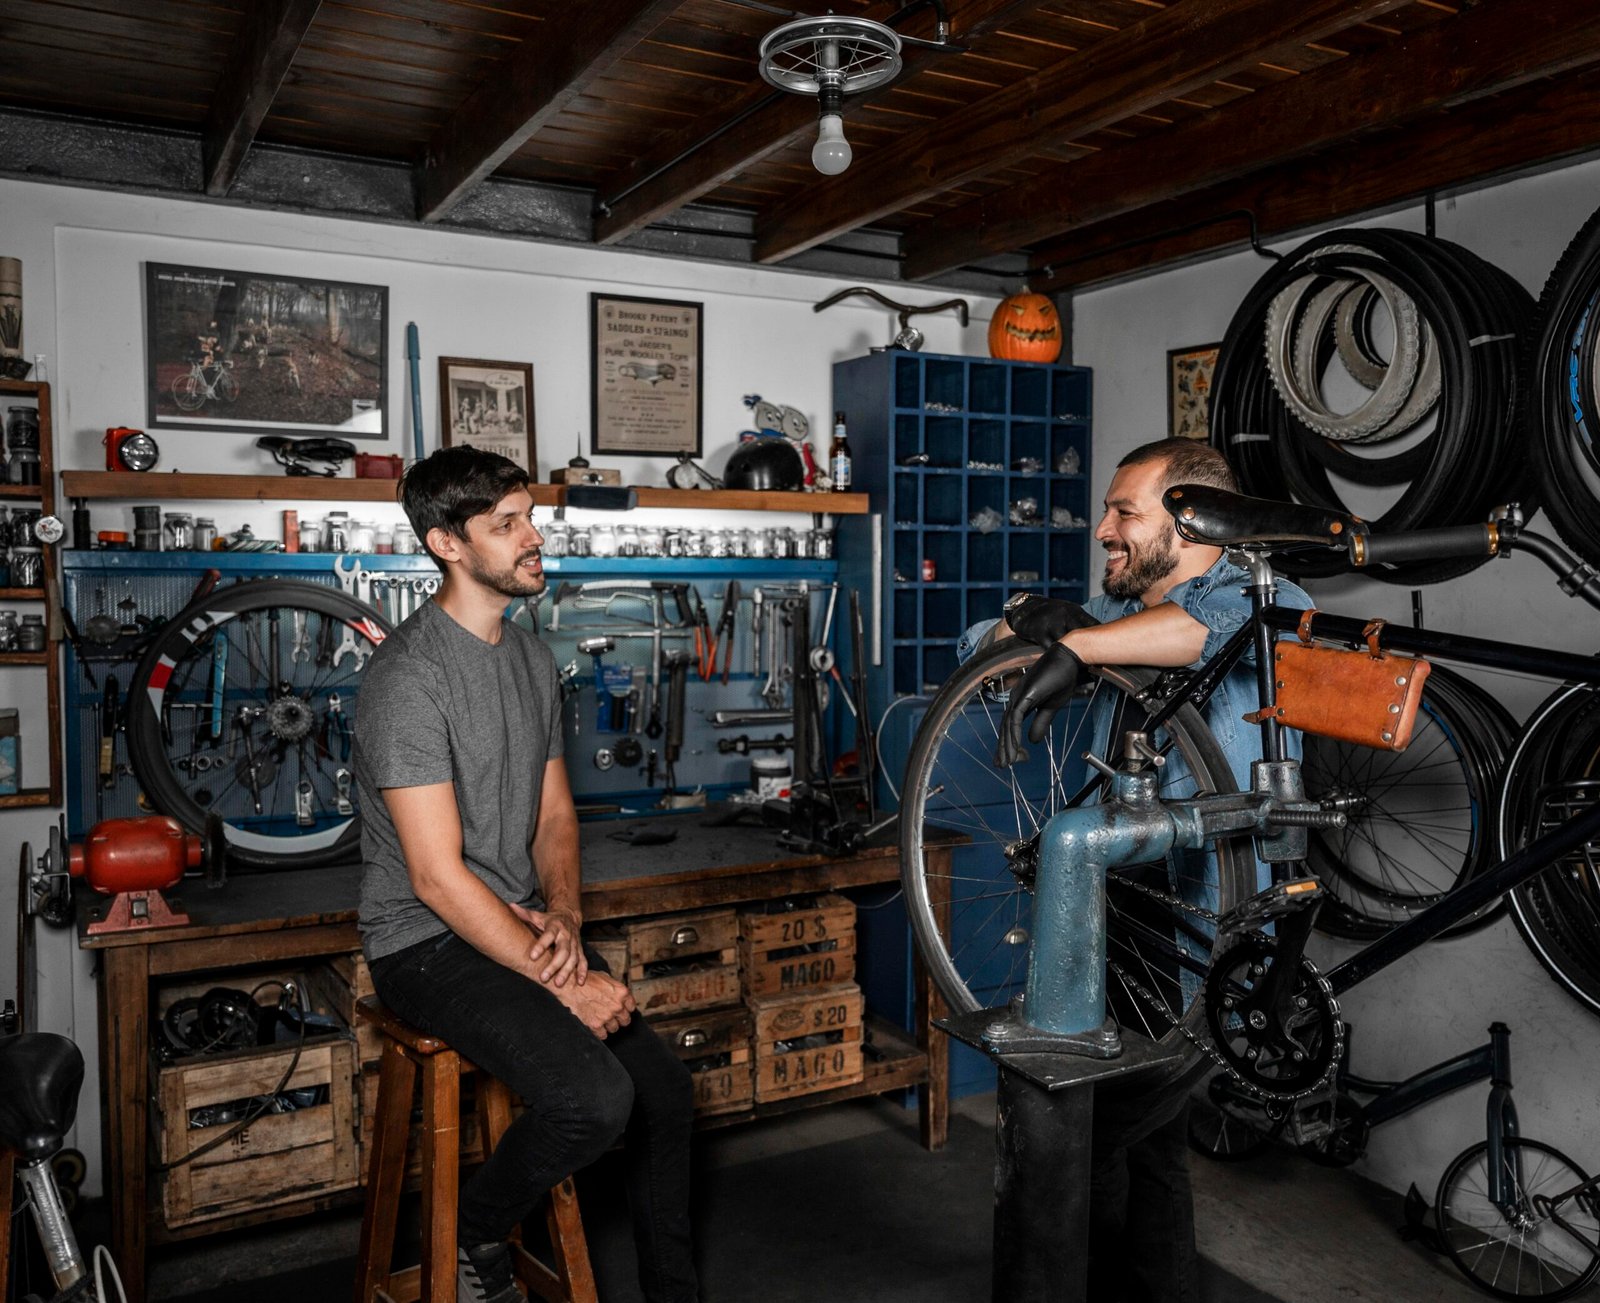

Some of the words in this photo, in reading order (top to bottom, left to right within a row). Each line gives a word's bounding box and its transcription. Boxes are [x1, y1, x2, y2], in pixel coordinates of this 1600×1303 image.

[618, 310, 647, 321] BROOKS
[650, 312, 679, 323] PATENT
[607, 323, 644, 335] SADDLES
[782, 918, 804, 942] 20
[780, 957, 836, 992] MAGO
[827, 1004, 847, 1026] 20
[774, 1050, 844, 1084] MAGO
